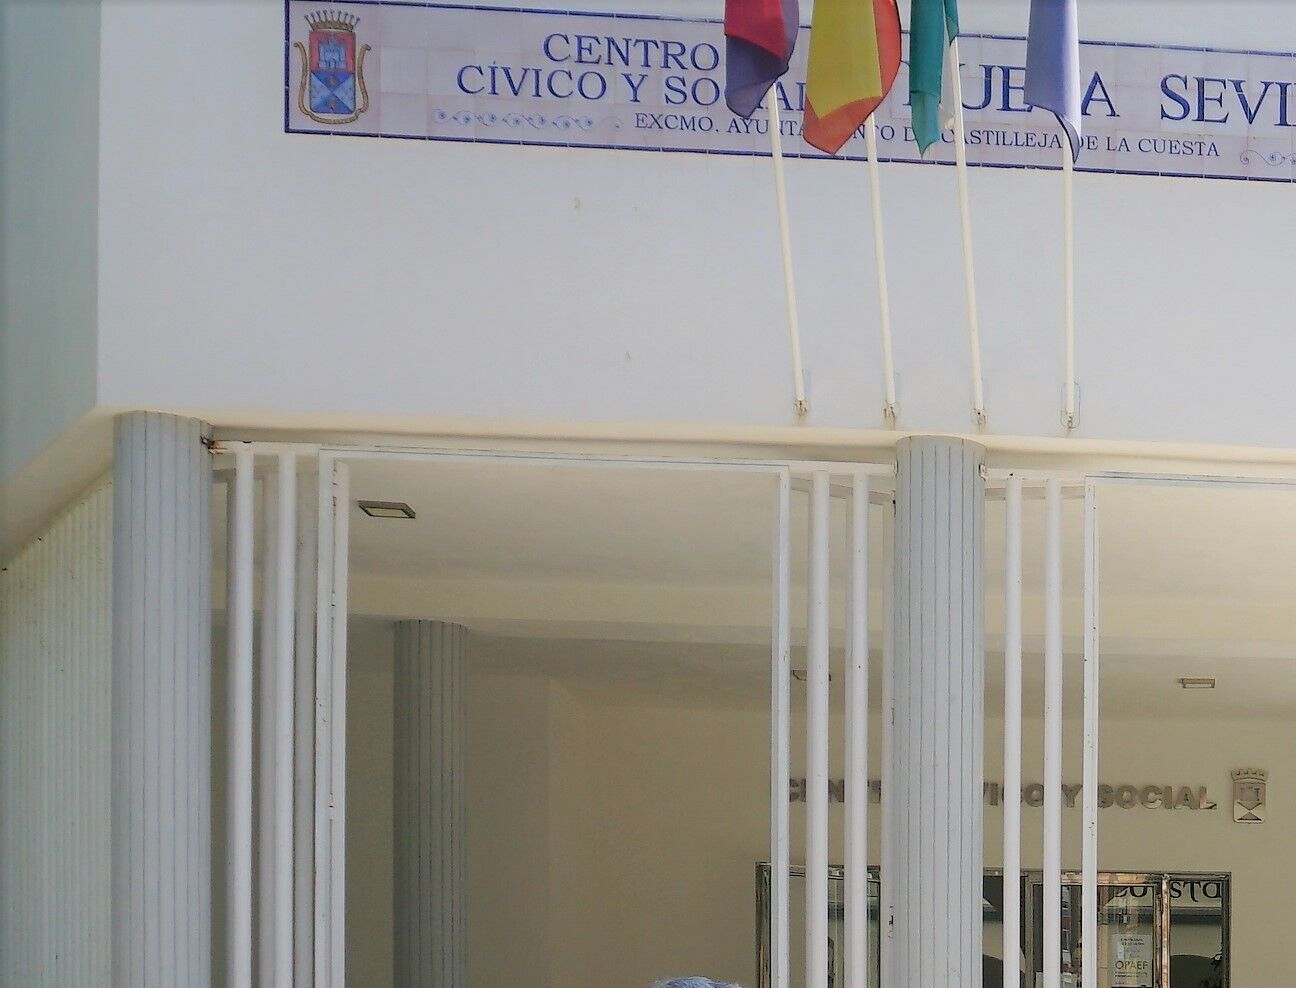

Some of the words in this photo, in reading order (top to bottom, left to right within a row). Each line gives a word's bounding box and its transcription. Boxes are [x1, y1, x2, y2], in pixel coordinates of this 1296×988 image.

[543, 33, 720, 71] CENTRO
[456, 60, 608, 101] CÍVICO
[621, 72, 649, 103] Y
[664, 75, 806, 112] SOA
[901, 60, 1121, 118] UEA
[635, 112, 719, 133] EXCMO.
[941, 128, 1063, 149] CSTILLEJA
[1105, 136, 1131, 152] LA
[1138, 138, 1220, 157] CUESTA
[1097, 783, 1218, 810] SOCIAL
[1115, 960, 1149, 970] OPAEF
